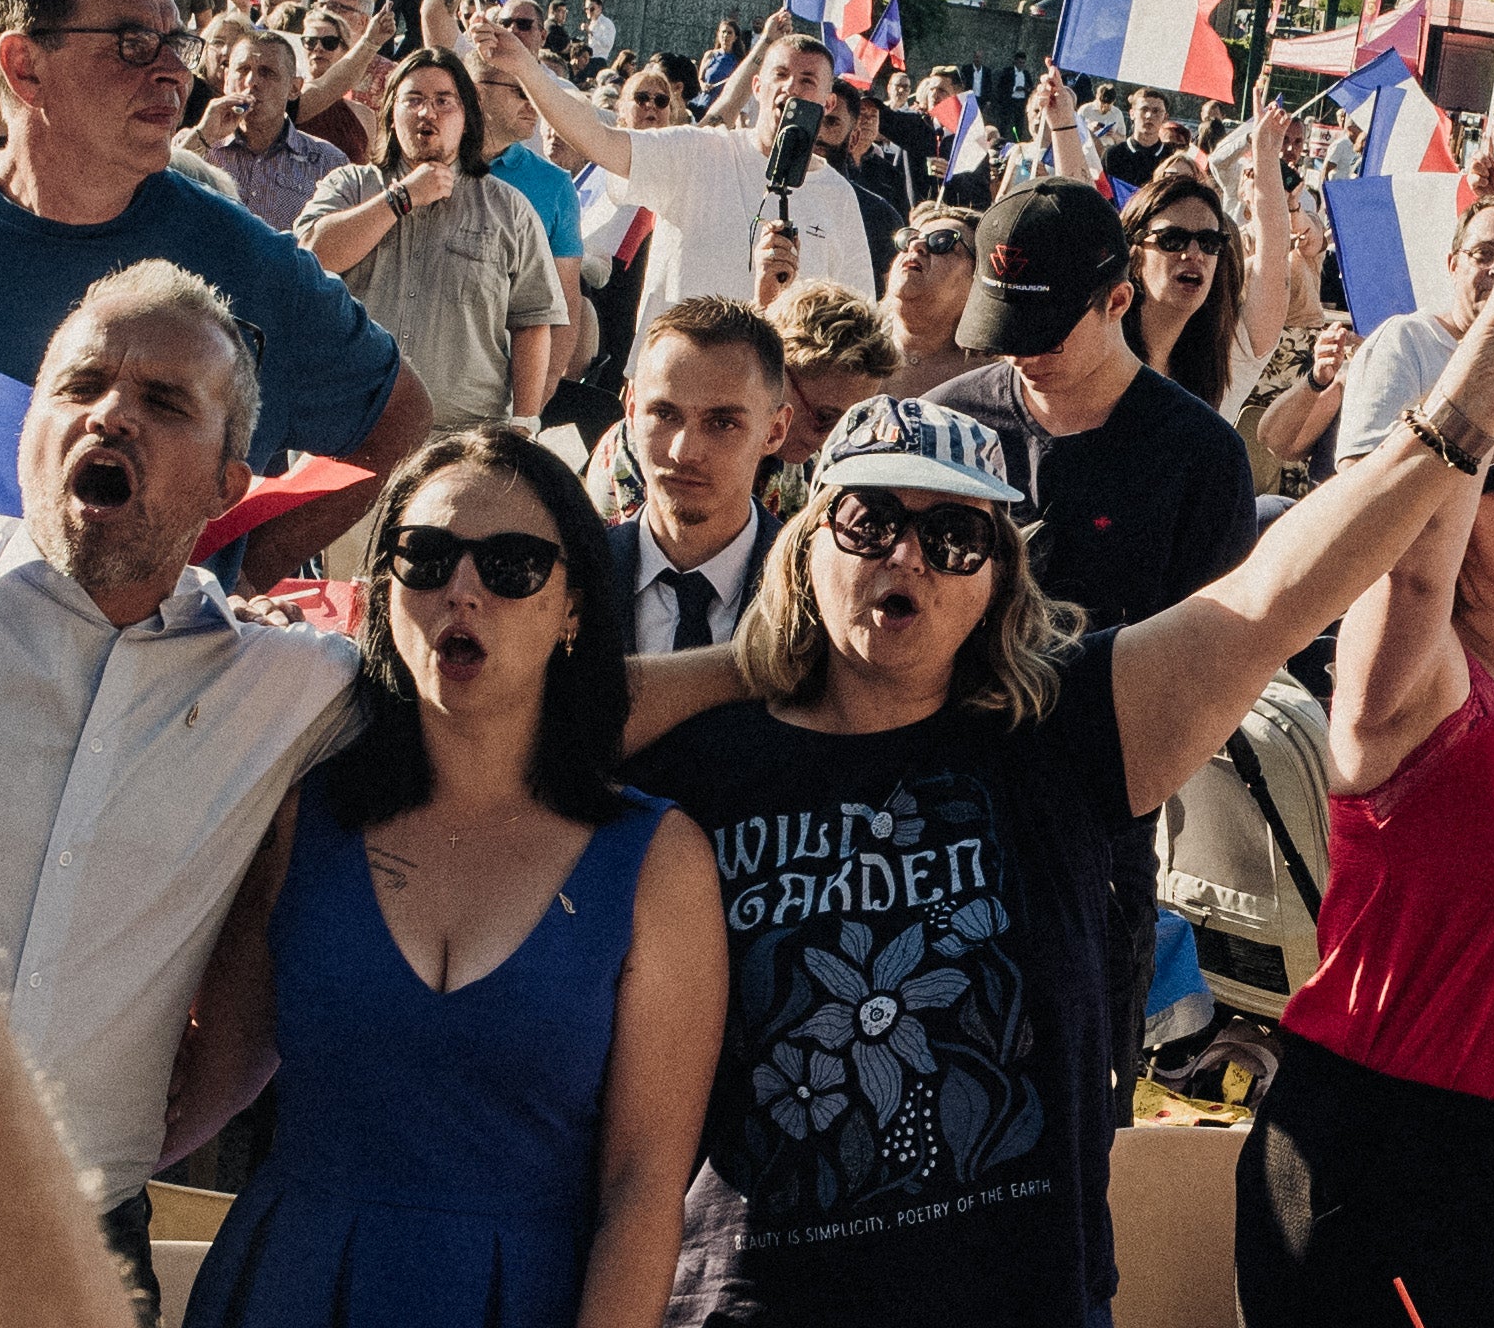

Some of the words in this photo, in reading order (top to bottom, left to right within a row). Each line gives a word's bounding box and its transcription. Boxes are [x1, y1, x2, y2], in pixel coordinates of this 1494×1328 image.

[714, 802, 888, 880] WILD
[728, 838, 986, 931] GARDEN
[735, 1231, 781, 1250] BEAUTY
[787, 1230, 800, 1245] IS
[897, 1201, 950, 1227] POETRY
[957, 1196, 975, 1213] OF
[980, 1185, 1004, 1205] THE
[1010, 1178, 1052, 1199] EARTH
